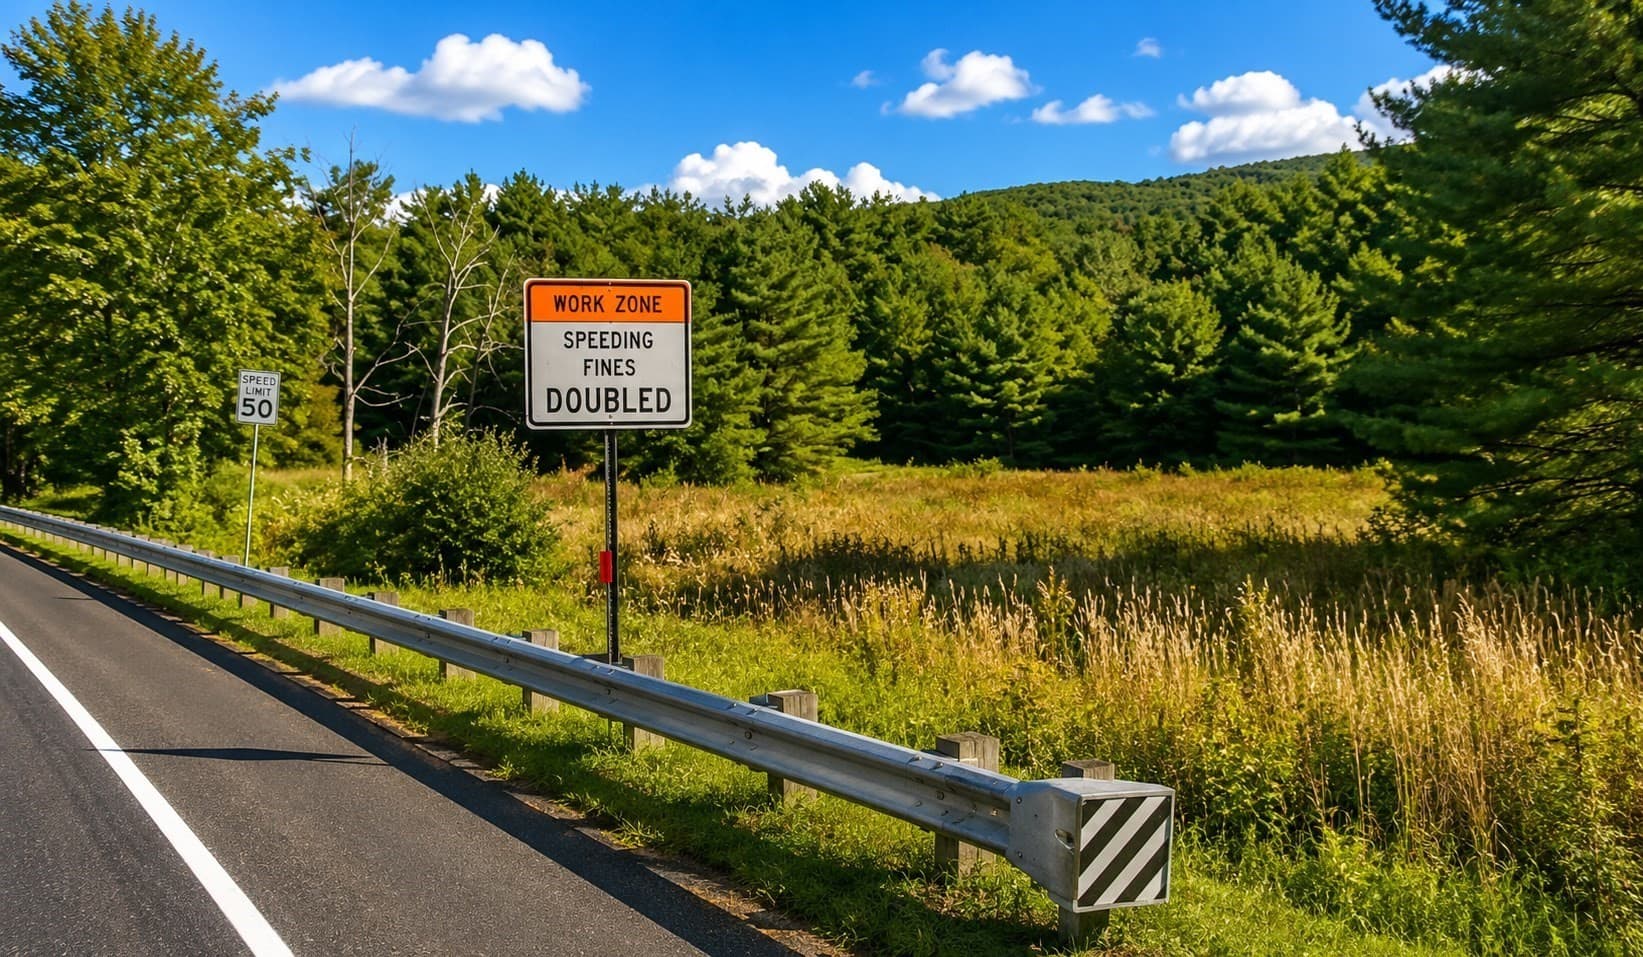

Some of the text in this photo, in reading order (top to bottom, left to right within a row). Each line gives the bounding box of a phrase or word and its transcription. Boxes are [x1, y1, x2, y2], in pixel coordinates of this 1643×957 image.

[553, 295, 663, 313] WORK ZONE
[563, 331, 654, 349] SPEEDING
[583, 358, 636, 377] FINES
[242, 375, 276, 386] SPEED
[245, 386, 272, 396] LIMIT
[241, 397, 273, 419] 50
[546, 387, 672, 414] DOUBLED
